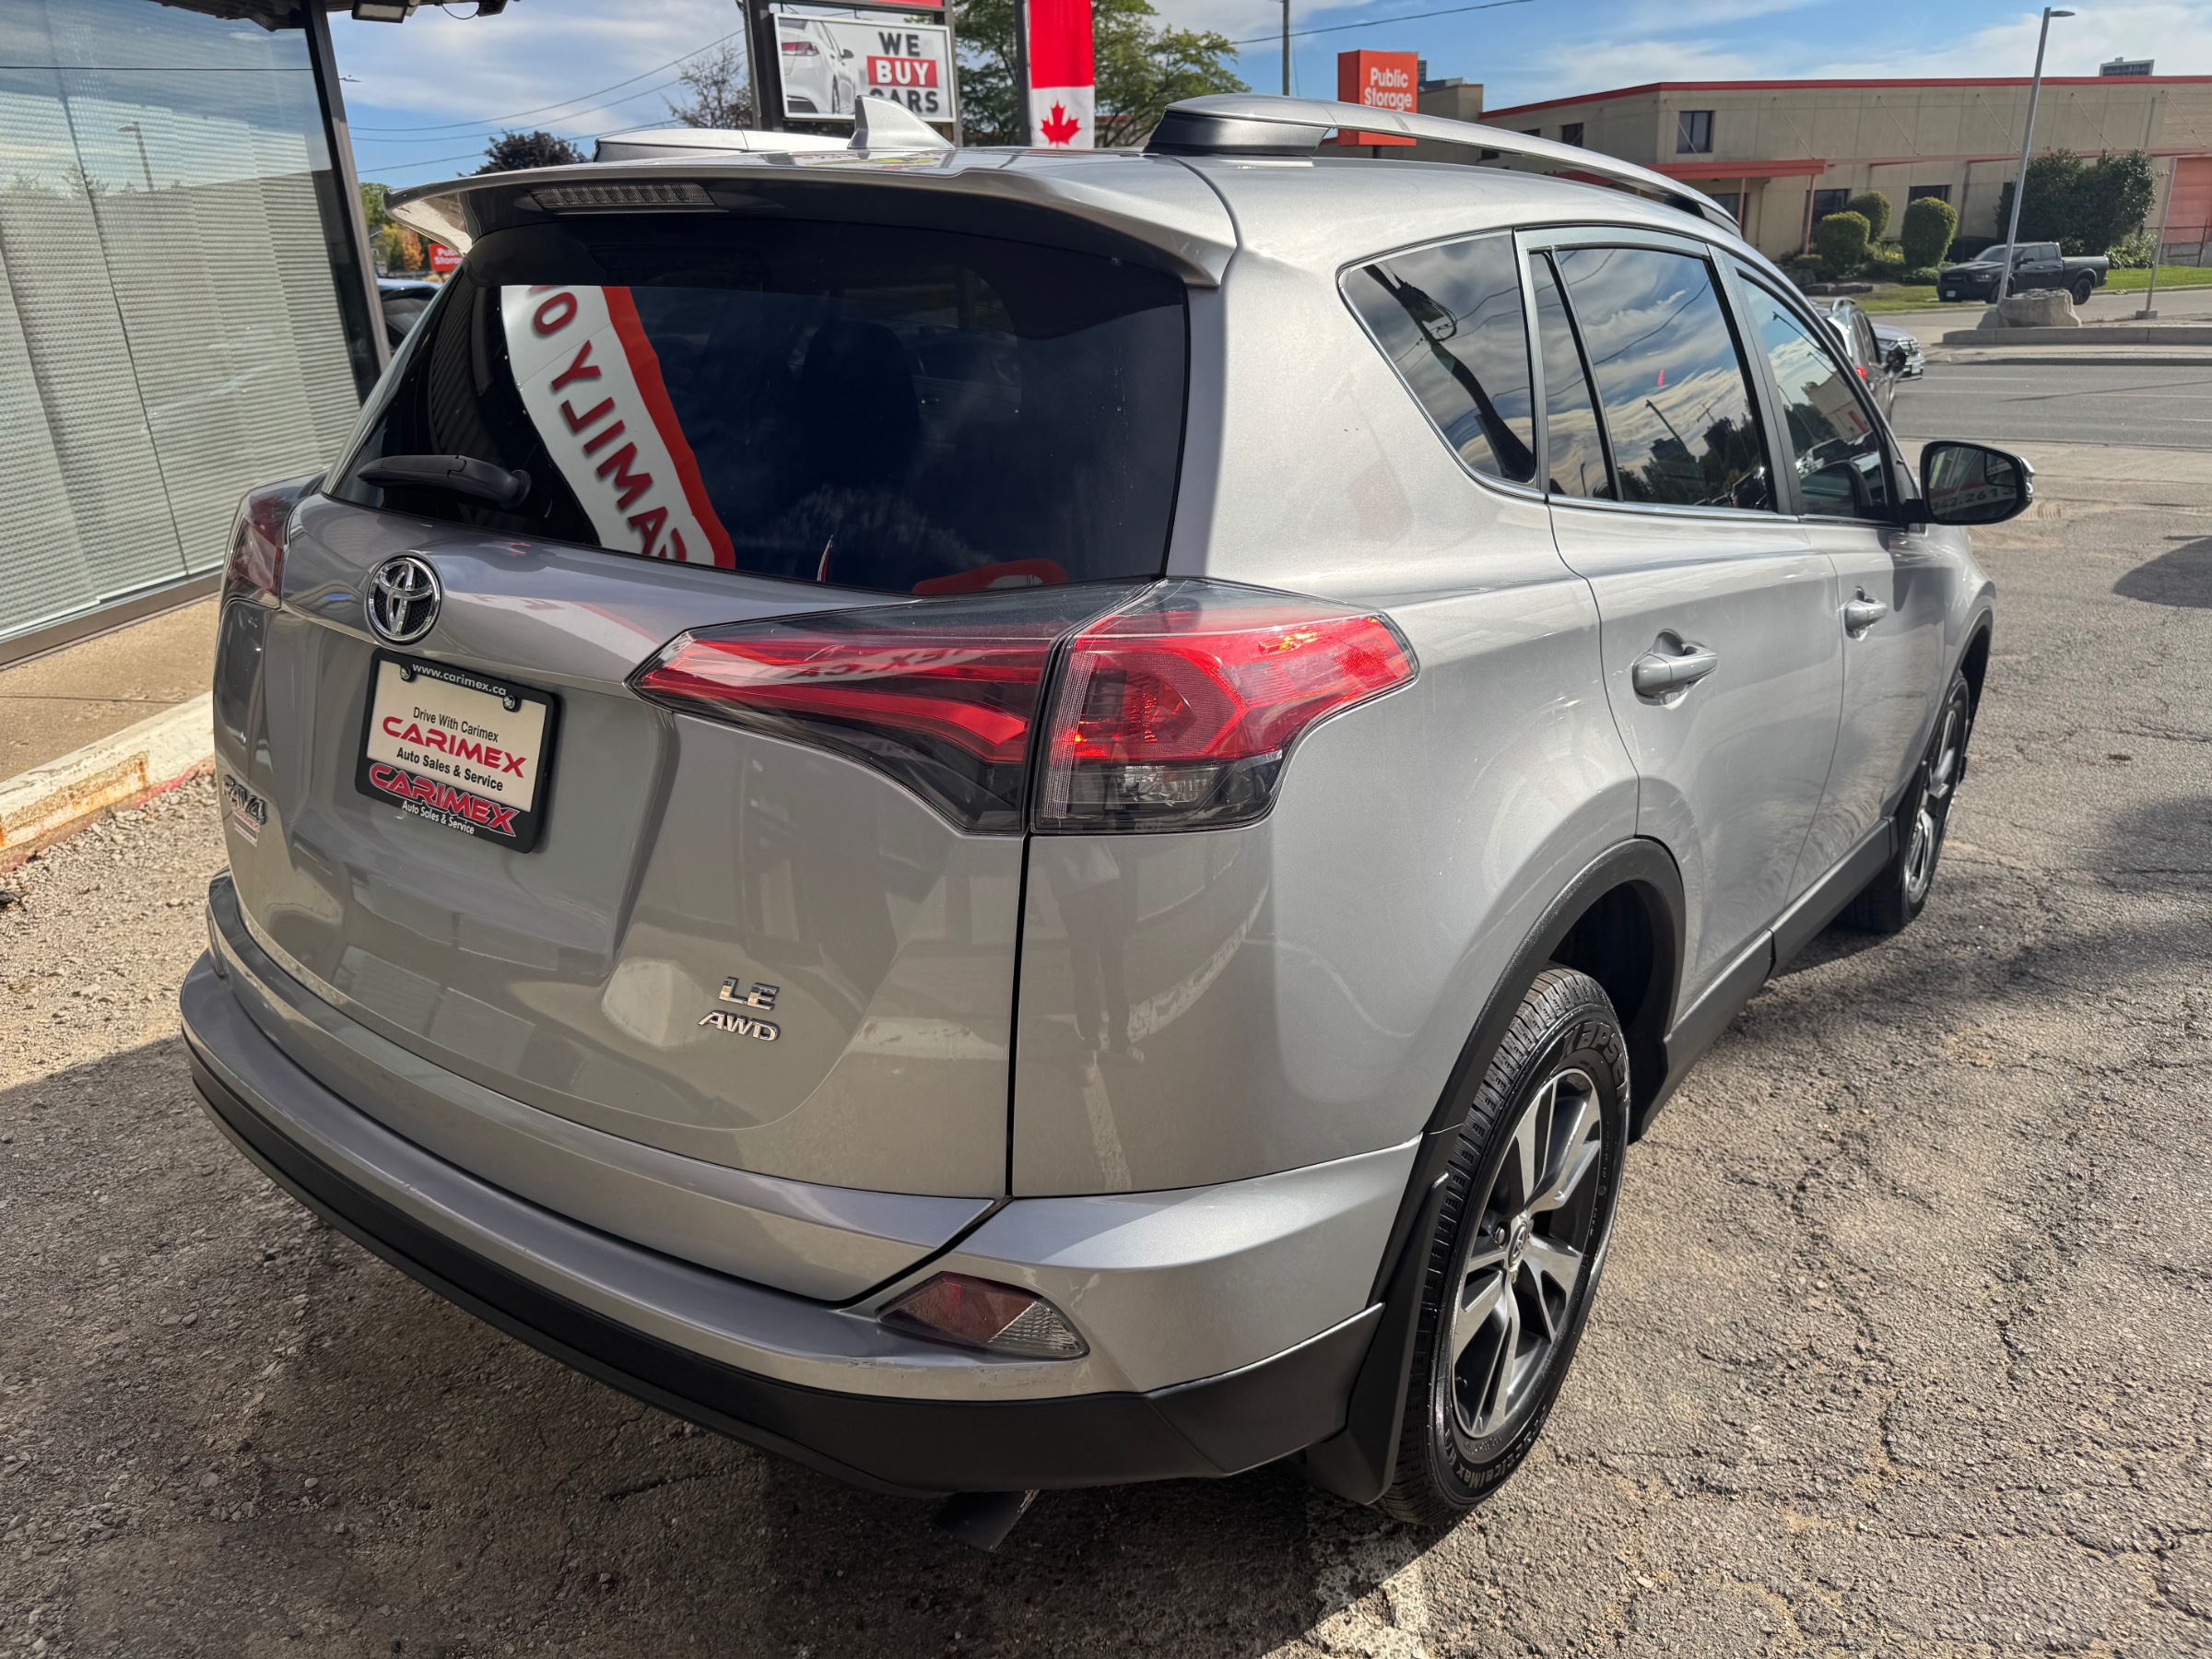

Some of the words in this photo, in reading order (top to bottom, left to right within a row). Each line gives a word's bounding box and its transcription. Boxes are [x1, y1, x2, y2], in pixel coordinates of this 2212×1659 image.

[878, 31, 921, 57] WE
[876, 59, 929, 86] BUY
[1370, 66, 1408, 88] Public
[1364, 87, 1413, 112] Storage
[412, 664, 507, 696] www.carimex.ca
[413, 706, 436, 724] Drive
[439, 713, 458, 731] With
[461, 721, 499, 743] Carimex
[382, 716, 527, 778] CARIMEX
[396, 747, 419, 764] Auto
[423, 754, 451, 774] Sales
[453, 764, 461, 777] &
[464, 768, 503, 791] Service
[370, 763, 519, 836] CARIMEX
[402, 800, 419, 815] Auto
[420, 806, 440, 822] Sales
[441, 814, 447, 825] &
[448, 818, 475, 835] Service
[719, 976, 780, 1011] LE
[698, 1010, 781, 1041] AWD
